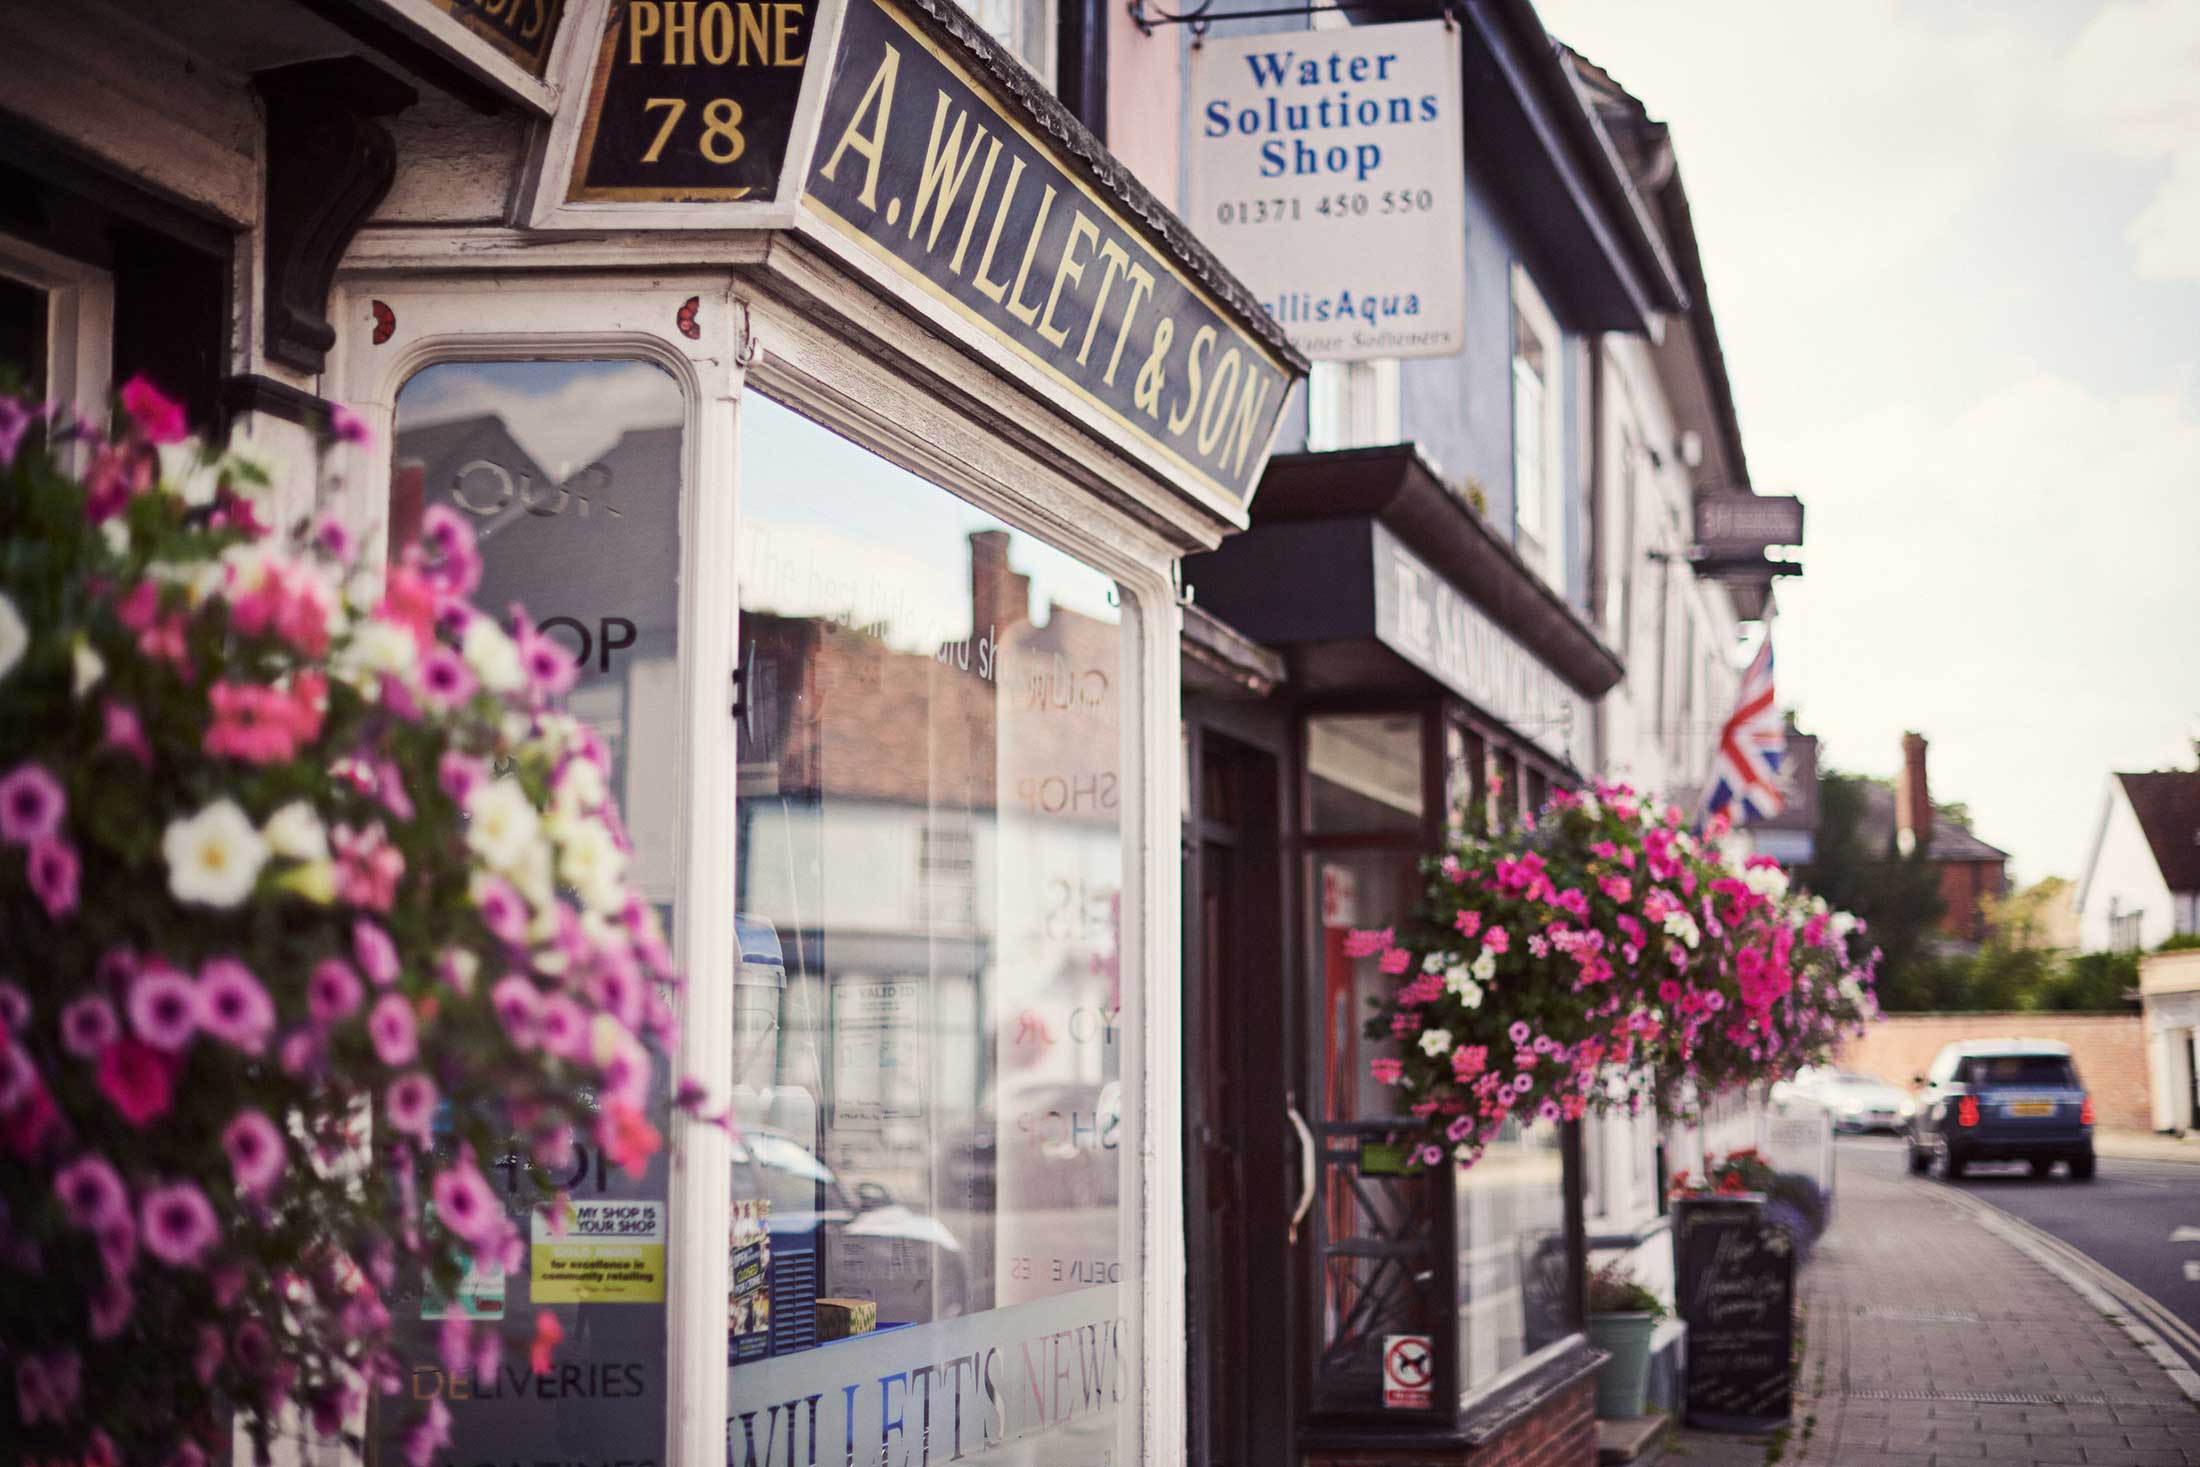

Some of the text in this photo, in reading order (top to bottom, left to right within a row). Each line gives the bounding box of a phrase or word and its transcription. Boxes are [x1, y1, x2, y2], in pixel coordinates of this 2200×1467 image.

[628, 0, 805, 66] PHONE
[1245, 50, 1398, 89] Water
[641, 98, 746, 165] 78
[1204, 92, 1440, 138] Solutions
[1259, 138, 1384, 182] Shop
[1217, 188, 1434, 225] 01371 450 550
[1168, 328, 1275, 481] SON
[452, 459, 624, 517] OUR
[534, 616, 638, 673] OP
[576, 1207, 656, 1219] MY SHOP IS
[577, 1220, 656, 1232] YOUR SHOP
[412, 1363, 644, 1400] DELIVERIES
[1019, 1317, 1129, 1433] NEWS
